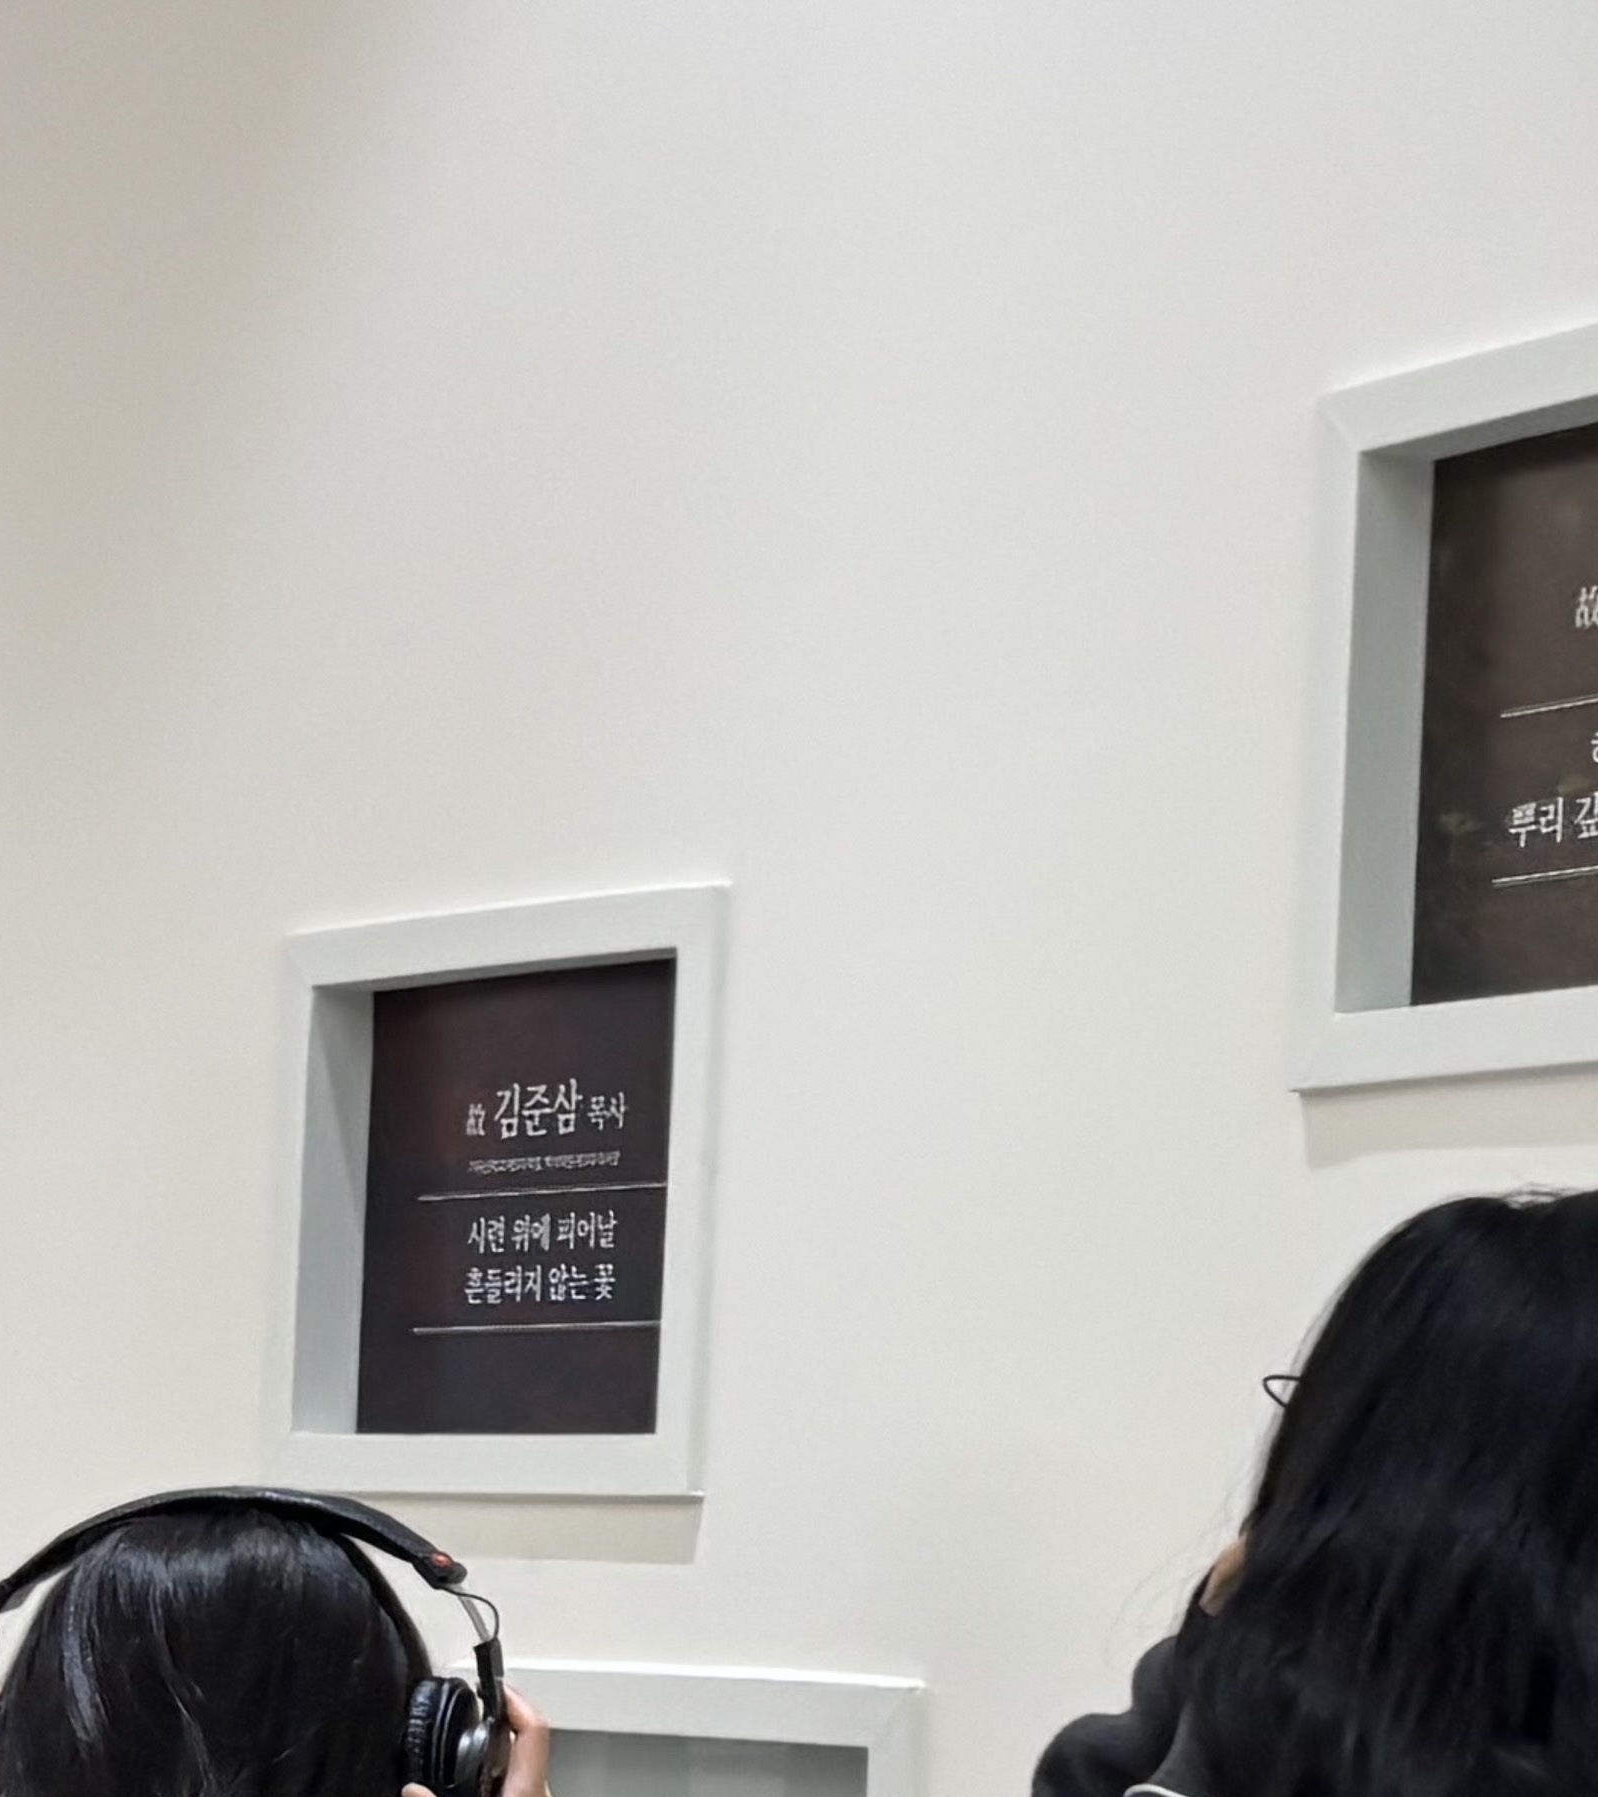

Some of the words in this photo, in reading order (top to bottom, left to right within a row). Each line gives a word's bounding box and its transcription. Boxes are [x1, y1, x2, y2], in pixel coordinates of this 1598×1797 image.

[1509, 796, 1564, 848] 뿌리
[494, 1078, 583, 1139] 김준삼
[587, 1092, 629, 1130] 목사
[467, 1216, 505, 1254] 시련
[511, 1213, 551, 1252] 위에
[557, 1209, 618, 1249] 피어날
[464, 1264, 542, 1304] 흔들리지
[549, 1263, 589, 1301] 않는
[594, 1264, 616, 1300] 꽃
